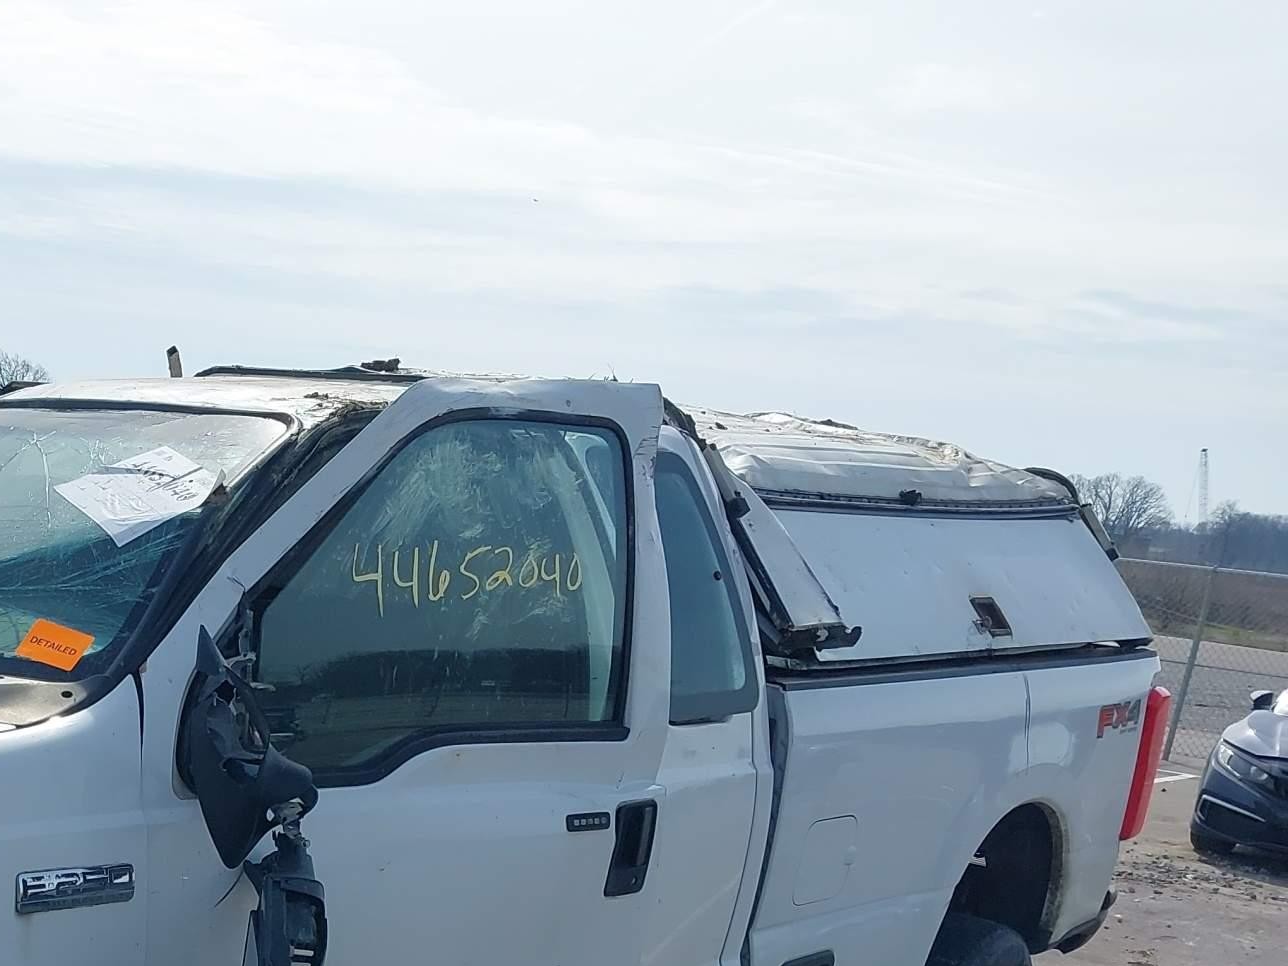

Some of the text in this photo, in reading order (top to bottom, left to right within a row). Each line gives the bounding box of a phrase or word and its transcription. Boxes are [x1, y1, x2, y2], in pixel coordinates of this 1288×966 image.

[352, 540, 583, 617] 44652040
[29, 636, 78, 656] DETAILED
[1096, 699, 1141, 738] FX4
